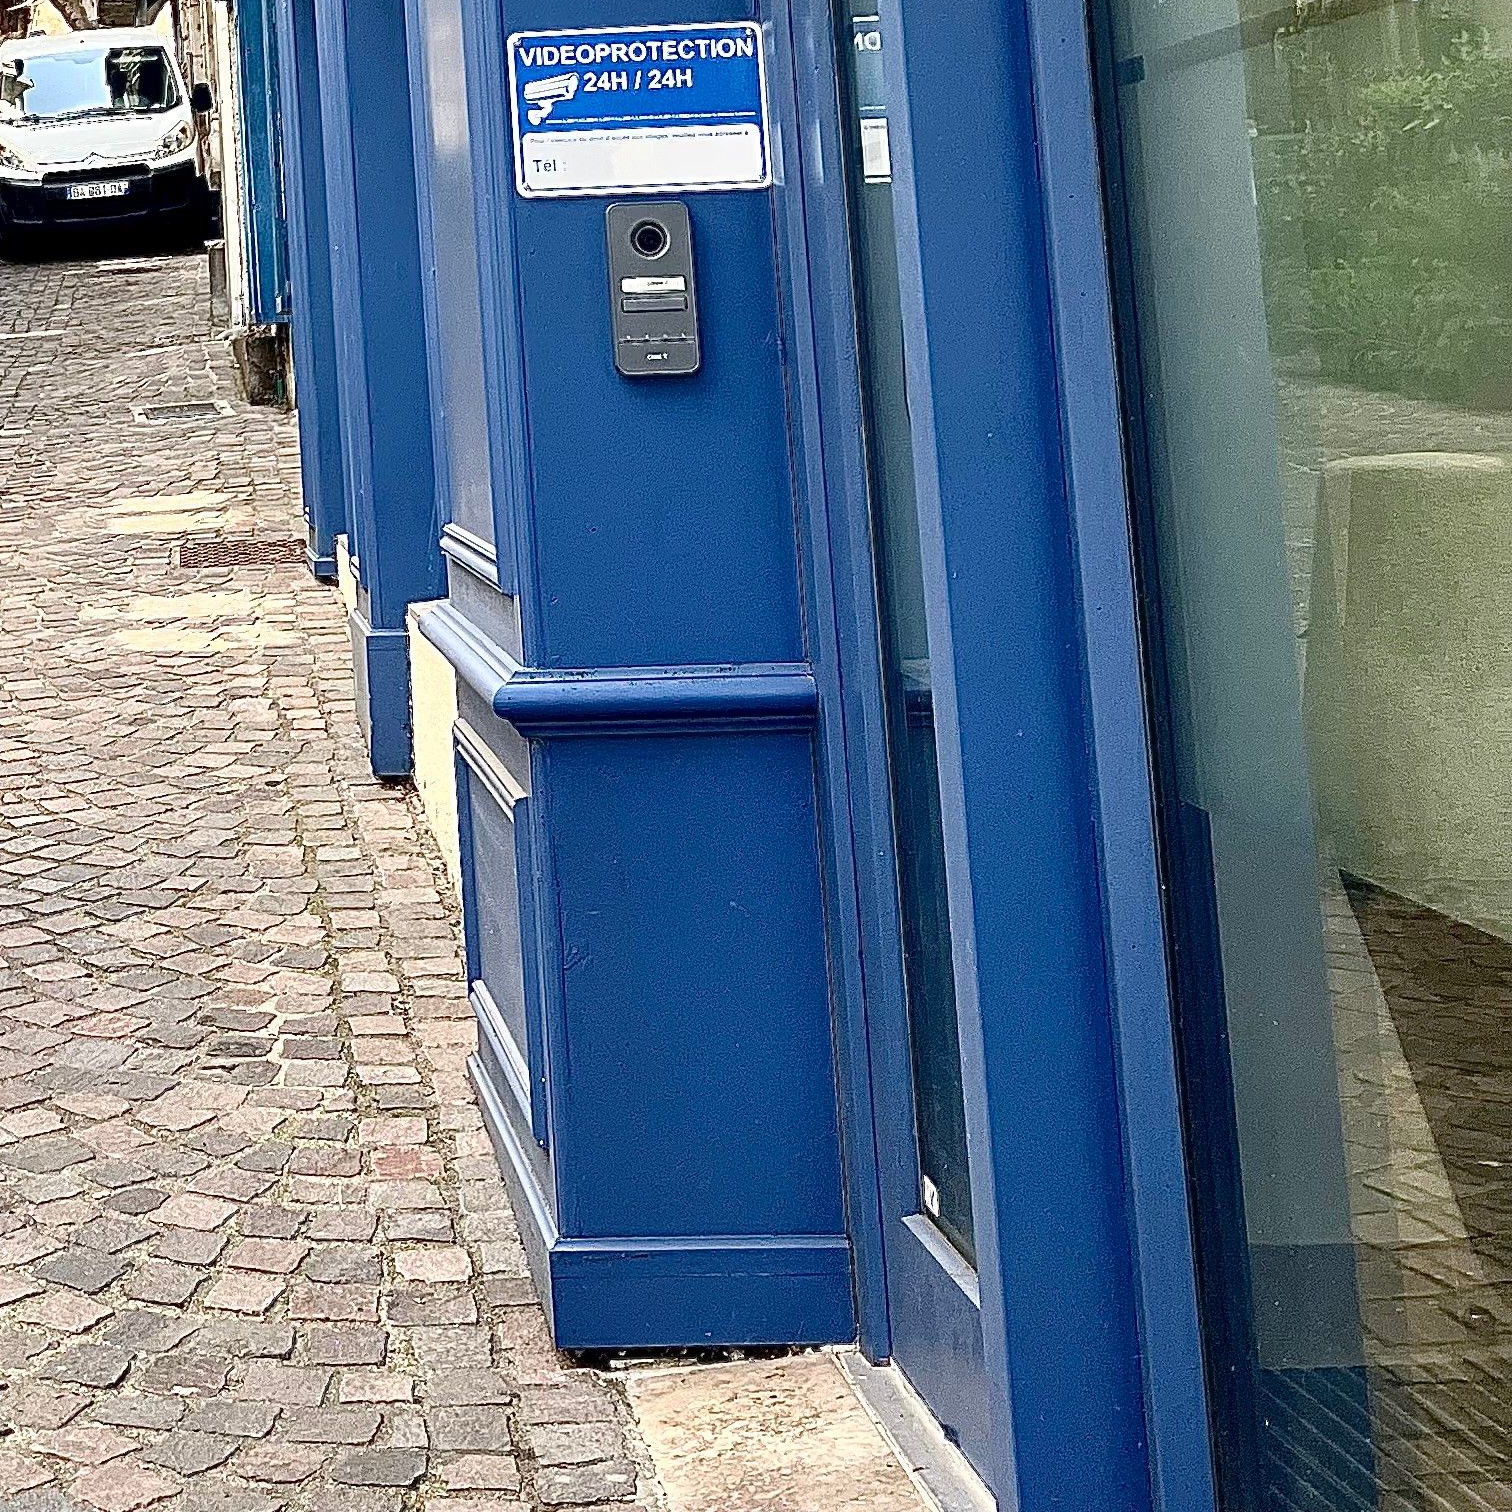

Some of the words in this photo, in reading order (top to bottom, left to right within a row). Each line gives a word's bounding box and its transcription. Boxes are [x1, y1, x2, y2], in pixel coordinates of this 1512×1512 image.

[518, 37, 754, 67] VIDEOPROTECTION
[583, 71, 628, 92] 24H
[633, 70, 642, 91] /
[648, 68, 693, 89] 24H
